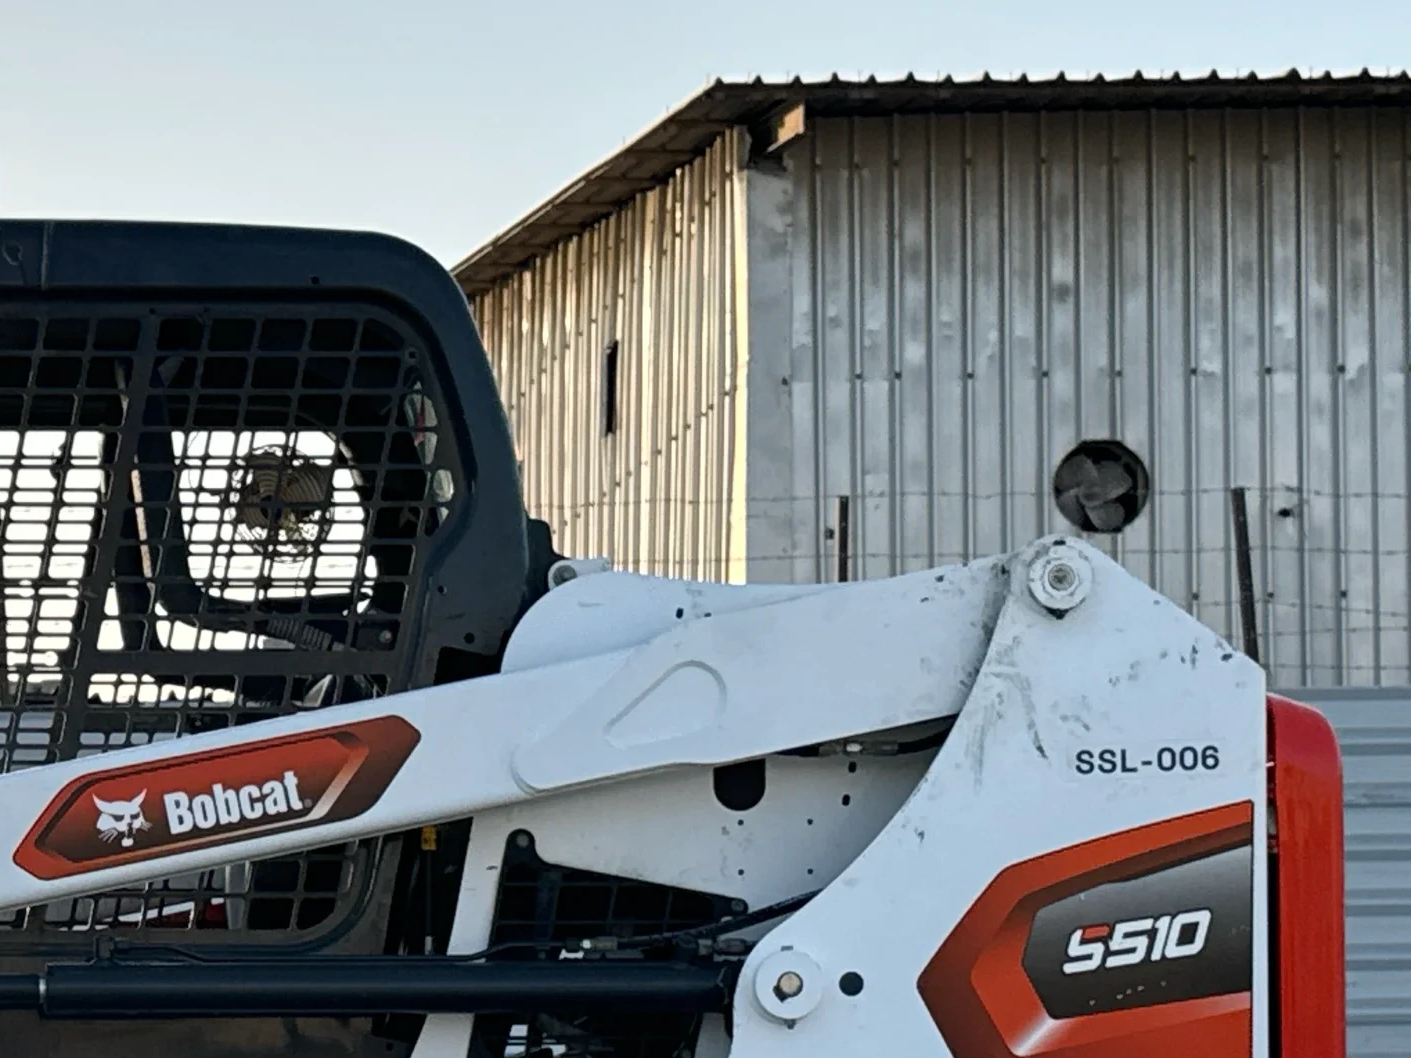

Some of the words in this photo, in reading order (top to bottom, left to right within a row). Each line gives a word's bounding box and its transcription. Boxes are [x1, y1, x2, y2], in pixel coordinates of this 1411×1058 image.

[1075, 745, 1220, 775] SSL-006
[163, 770, 303, 835] Bobcat
[1062, 908, 1212, 975] S510
